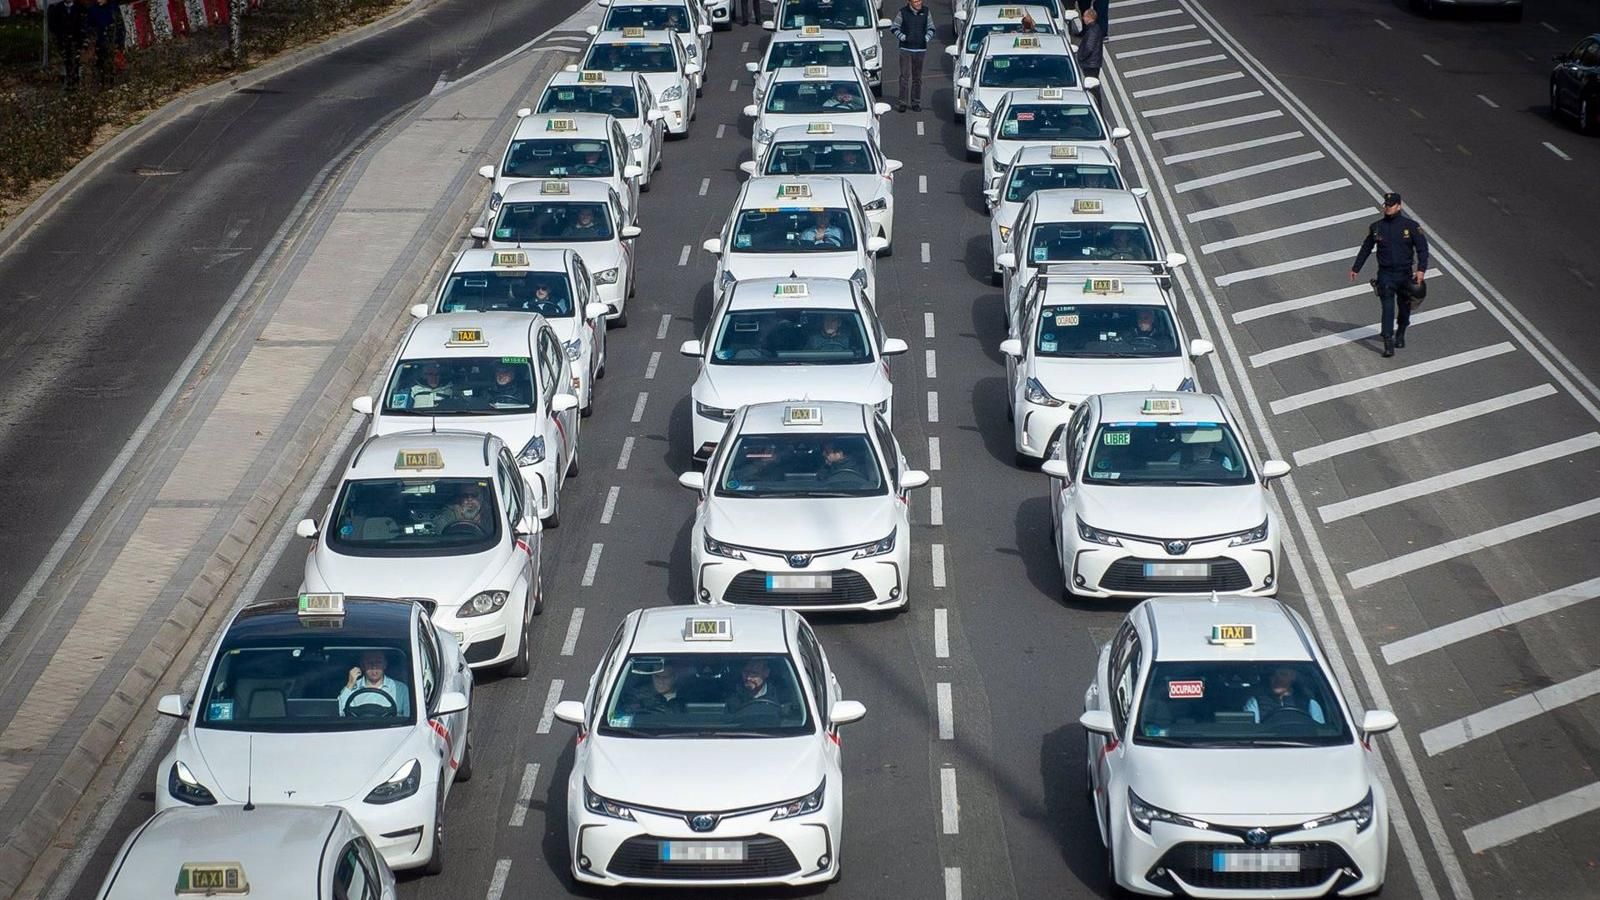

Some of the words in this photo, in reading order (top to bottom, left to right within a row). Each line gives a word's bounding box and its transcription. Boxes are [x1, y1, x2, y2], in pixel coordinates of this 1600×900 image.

[786, 186, 800, 194] TAXI
[1080, 201, 1094, 209] TAXI
[500, 254, 516, 264] TAXI
[1094, 280, 1111, 290] TAXI
[459, 330, 475, 341] TAXI
[793, 409, 810, 419] TAXI
[1105, 433, 1129, 444] LIBRE
[407, 454, 427, 465] TAXI
[308, 596, 330, 608] TAXI
[695, 621, 717, 633] TAXI
[1221, 626, 1244, 639] TAXI
[1170, 684, 1201, 694] OCUPADO
[194, 870, 222, 887] TAXI
